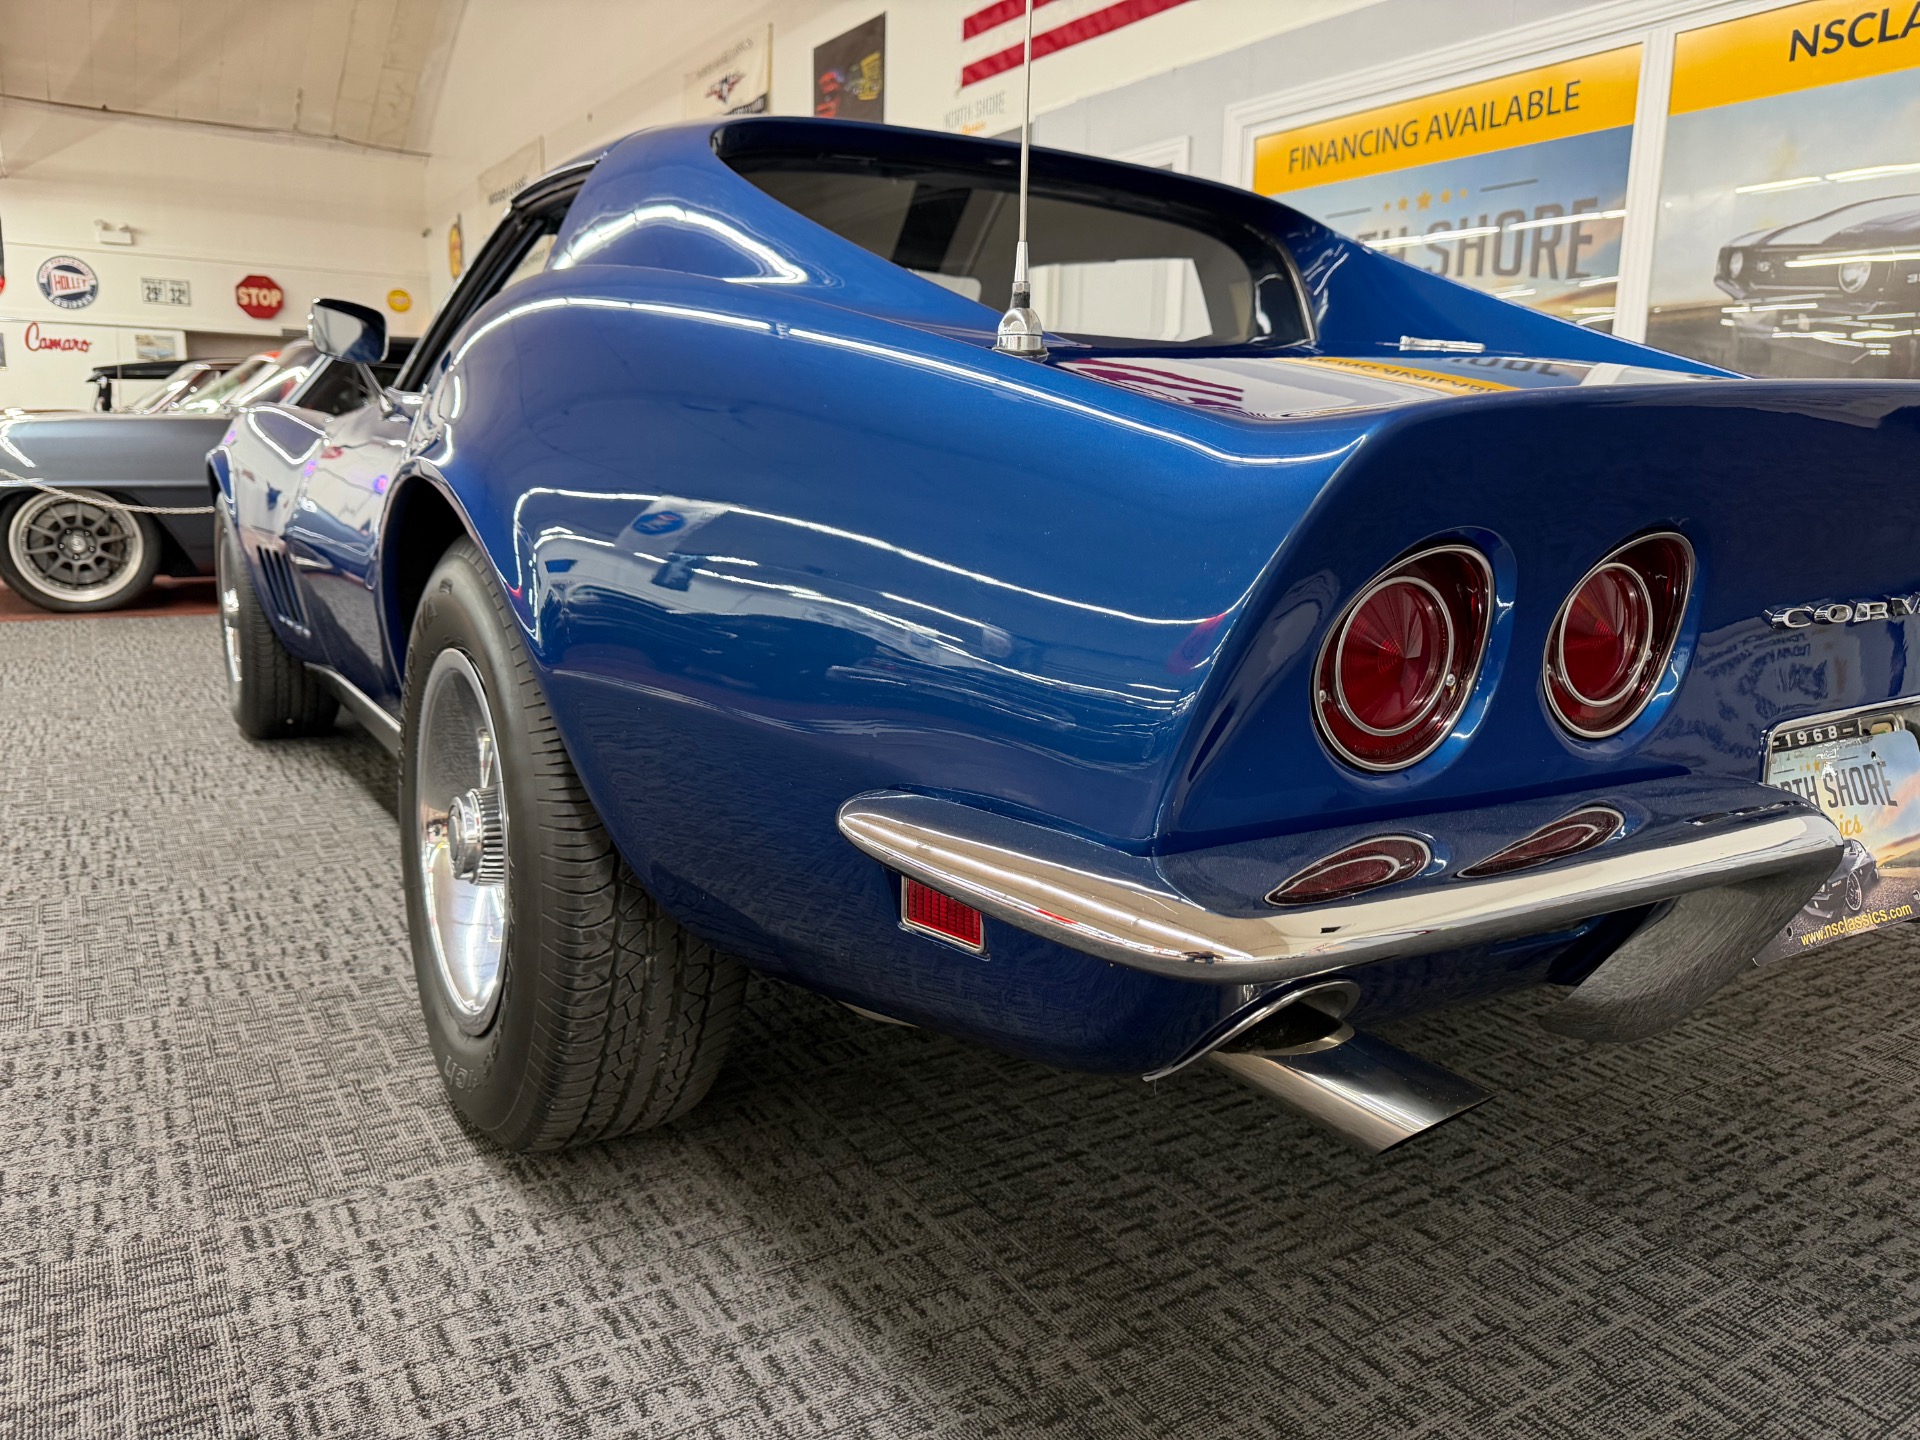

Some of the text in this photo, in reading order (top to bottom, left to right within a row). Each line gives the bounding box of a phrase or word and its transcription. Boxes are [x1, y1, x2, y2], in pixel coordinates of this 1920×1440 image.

[1288, 80, 1581, 173] FINANCING AVAILABLE
[1424, 196, 1599, 280] SHORE
[238, 285, 282, 308] STOP
[25, 321, 92, 352] Camaro
[1823, 760, 1898, 809] SHORE
[1800, 904, 1913, 946] www.nsclassics.com
